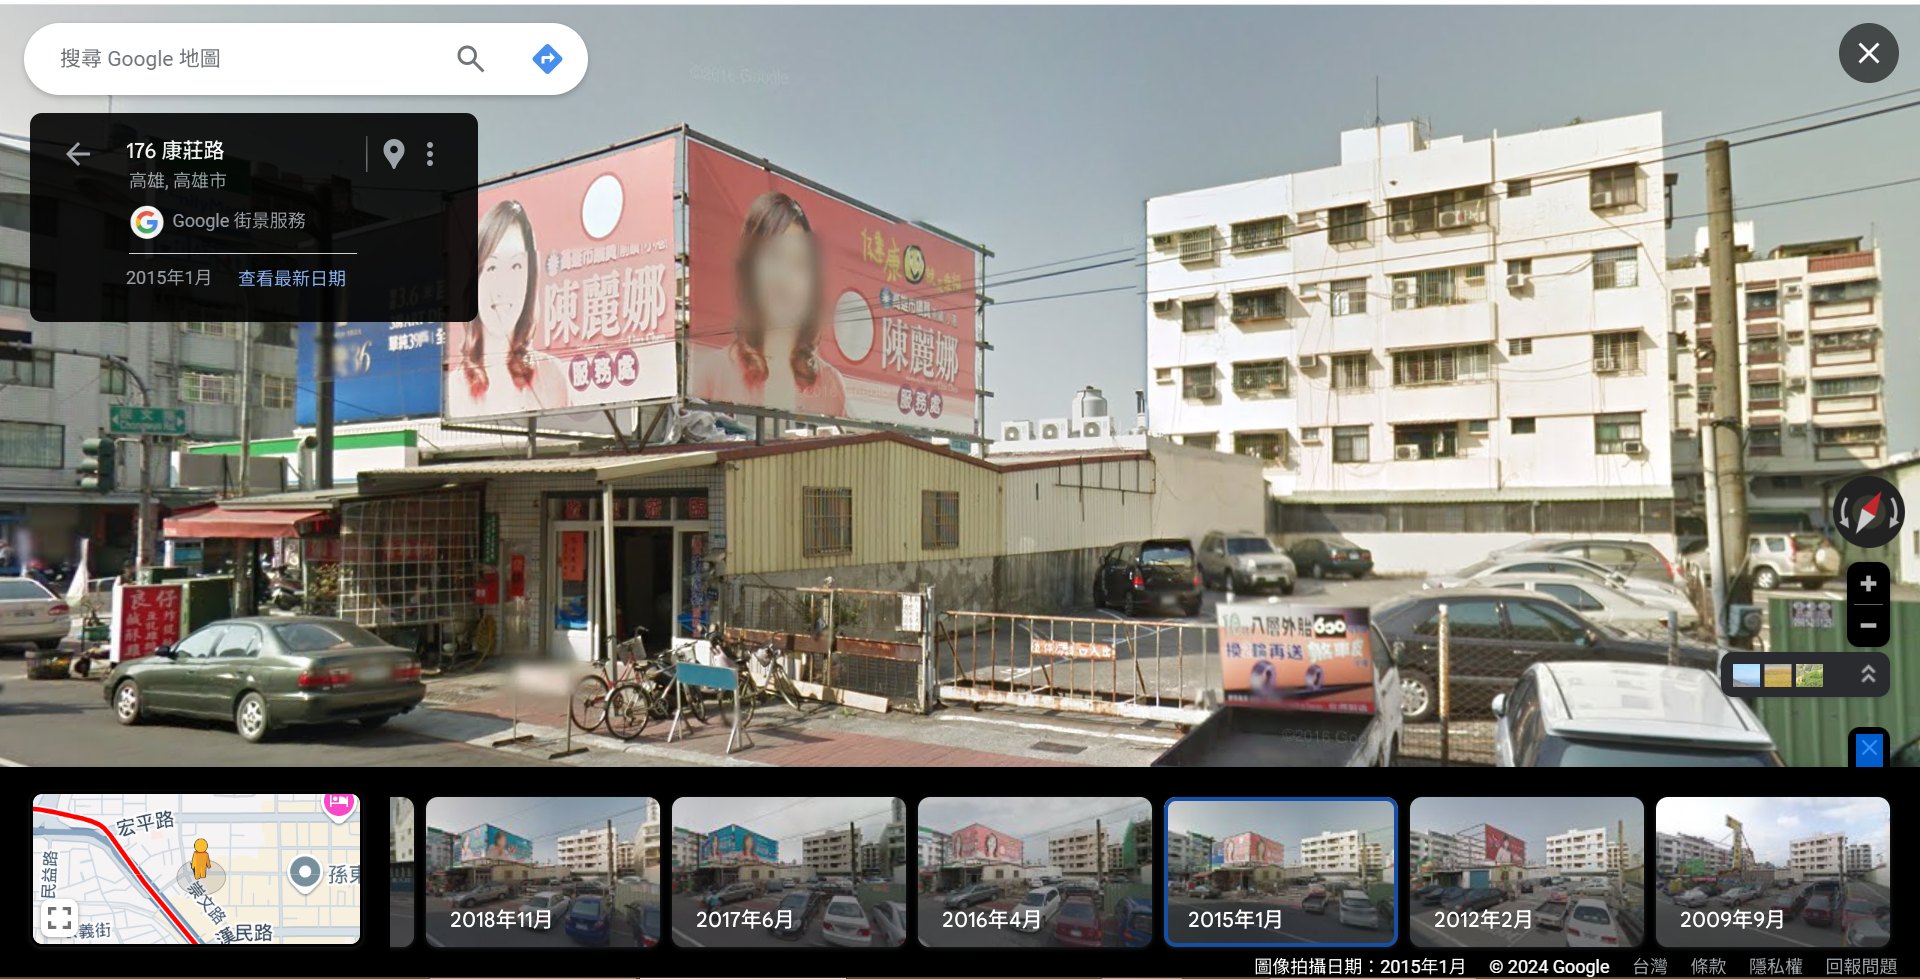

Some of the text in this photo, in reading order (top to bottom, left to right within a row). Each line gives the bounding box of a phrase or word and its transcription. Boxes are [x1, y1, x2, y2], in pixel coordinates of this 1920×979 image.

[543, 264, 667, 350] 陳麗娜
[881, 317, 959, 382] 陳麗娜
[571, 353, 637, 388] 服務處
[900, 387, 942, 416] 服務處
[1252, 615, 1313, 638] 八層外胎
